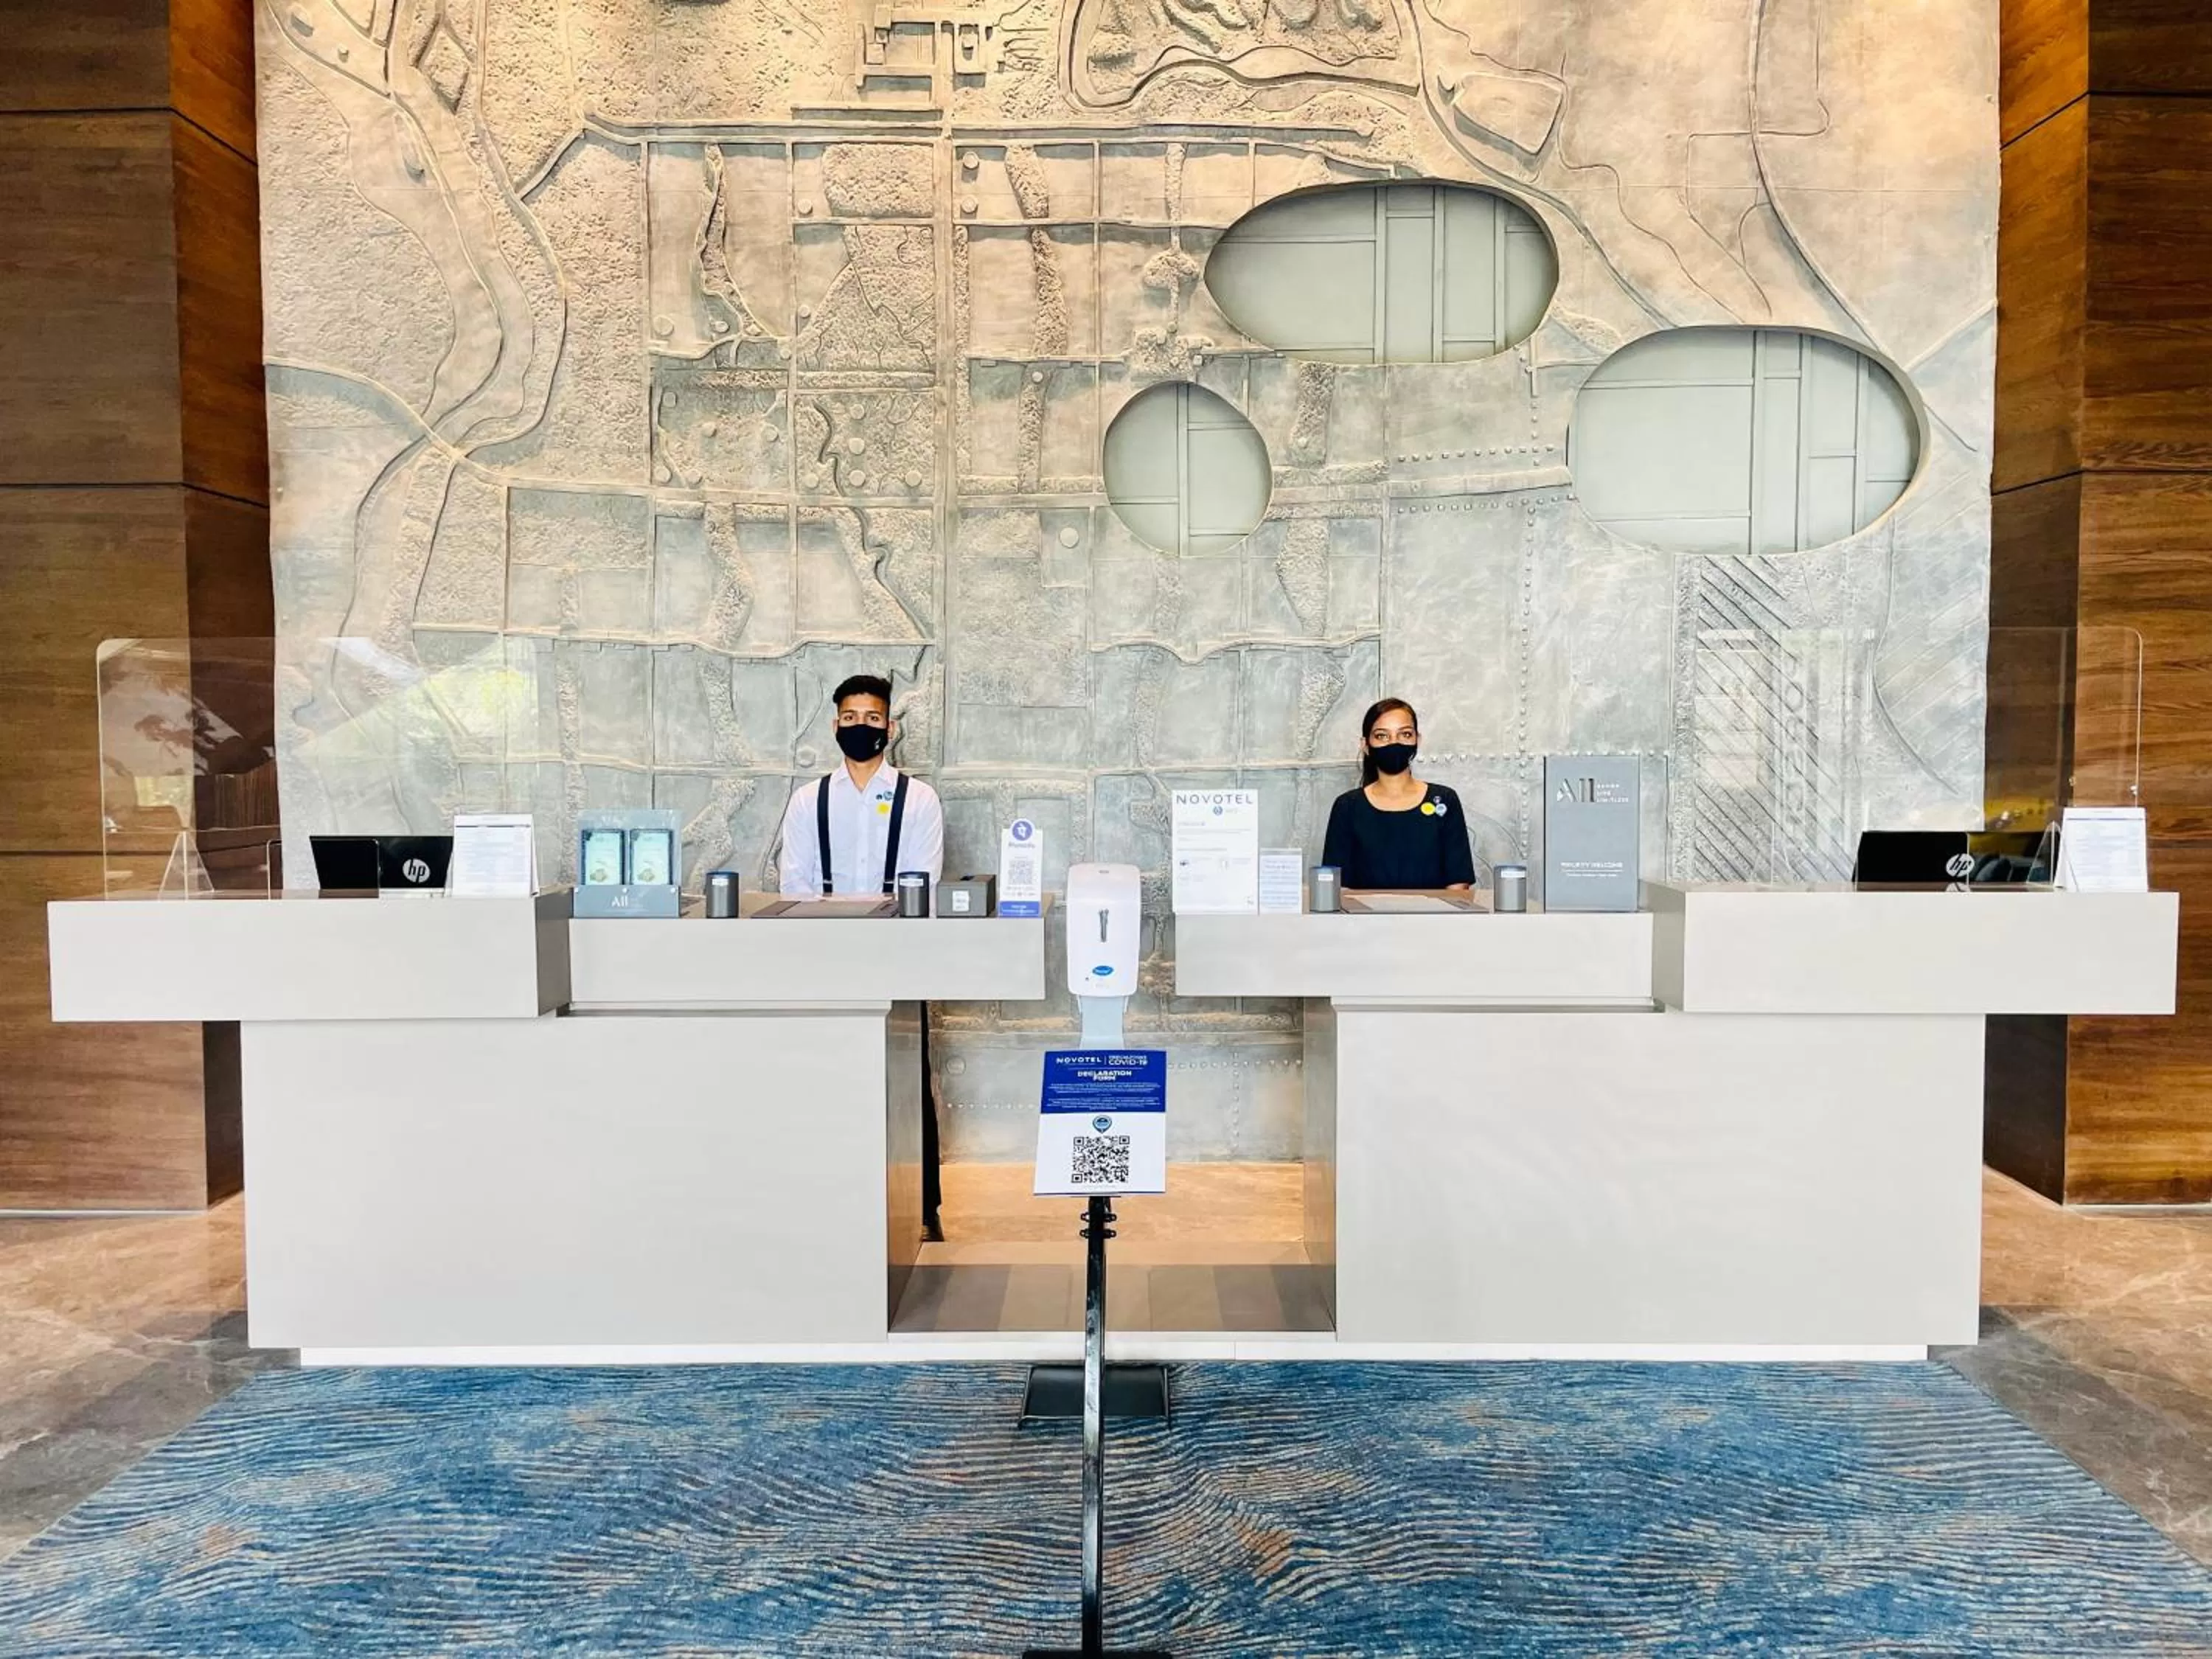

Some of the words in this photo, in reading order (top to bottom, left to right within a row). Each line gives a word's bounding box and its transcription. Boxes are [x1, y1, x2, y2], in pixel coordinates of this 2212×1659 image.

[1176, 794, 1253, 805] NOVOTEL
[406, 858, 428, 883] hp
[1948, 854, 1973, 877] hp
